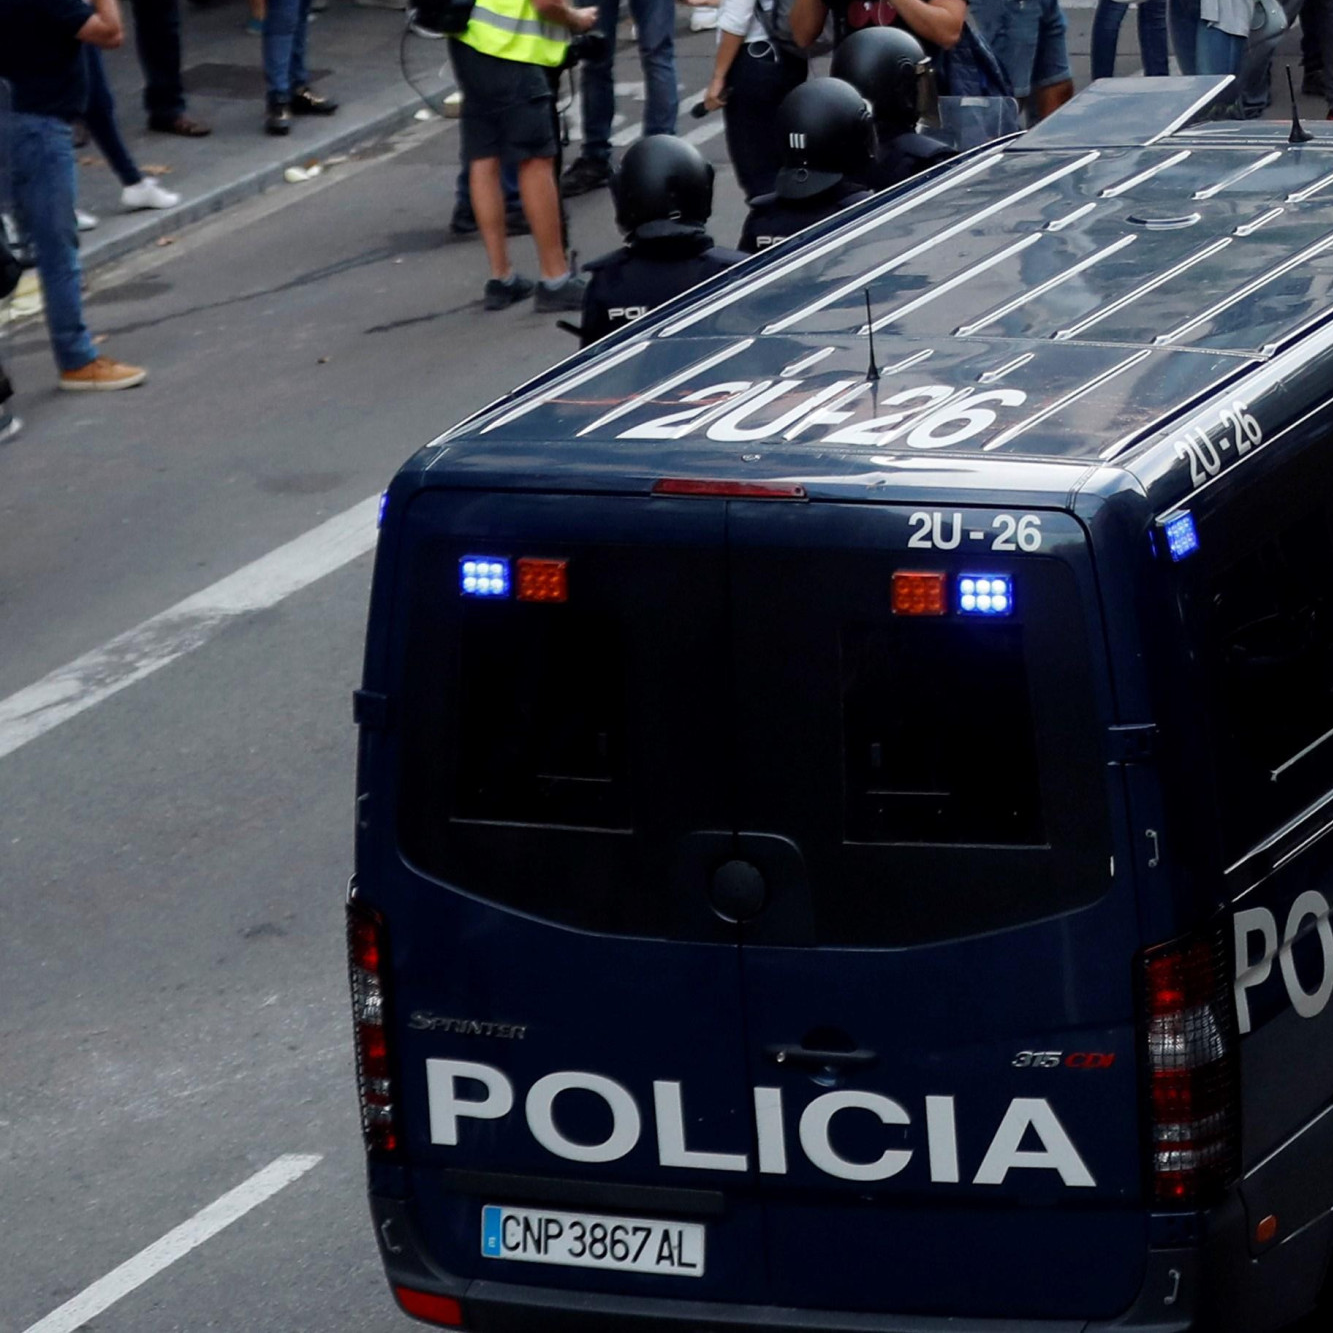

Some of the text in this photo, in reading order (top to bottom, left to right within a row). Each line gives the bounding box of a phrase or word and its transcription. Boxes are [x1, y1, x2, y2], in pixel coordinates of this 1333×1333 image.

[1011, 1050, 1116, 1069] 315 CDI
[425, 1058, 1098, 1188] POLICIA
